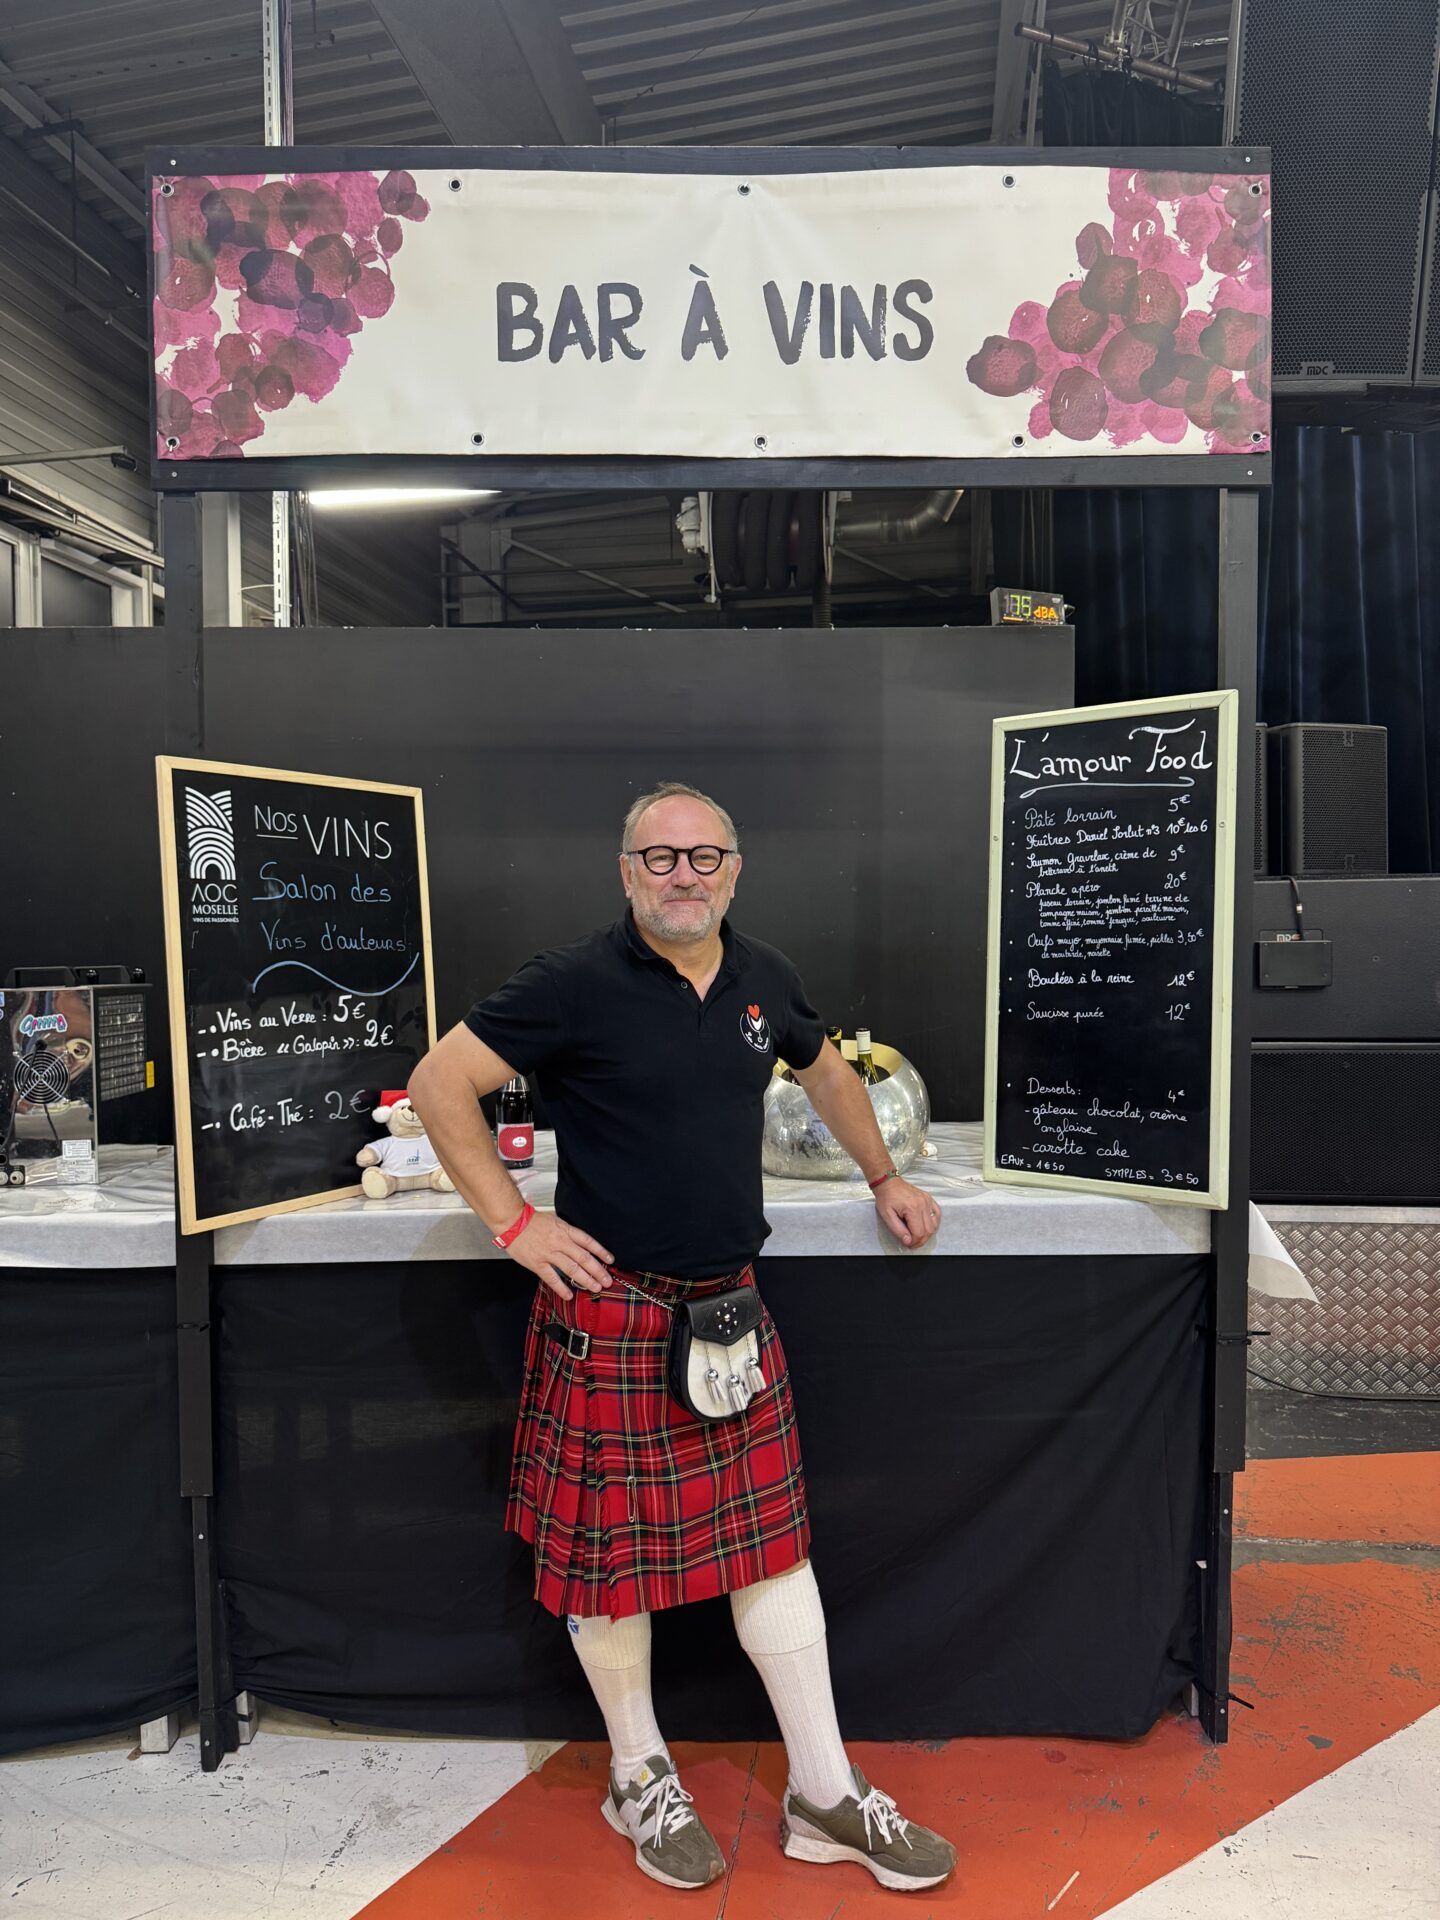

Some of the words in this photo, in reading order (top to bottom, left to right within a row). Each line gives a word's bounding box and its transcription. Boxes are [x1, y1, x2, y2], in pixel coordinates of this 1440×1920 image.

[496, 281, 647, 364] BAR
[681, 264, 729, 362] À
[762, 279, 934, 365] VINS
[1306, 366, 1329, 376] MDC
[1009, 732, 1132, 782] L'amour
[1128, 718, 1213, 773] Food
[1025, 808, 1056, 829] Pâté
[1064, 807, 1117, 824] lorrain
[1167, 794, 1191, 812] 5€
[303, 814, 392, 860] VINS
[1166, 817, 1186, 835] 10€
[1200, 819, 1208, 832] 6
[1026, 852, 1062, 869] Saumon
[1142, 846, 1157, 859] de
[1167, 844, 1186, 862] 9€
[252, 861, 337, 901] Salon
[351, 873, 391, 902] des
[1026, 882, 1068, 898] Planche
[1071, 881, 1101, 899] apéro
[1164, 871, 1188, 890] 20€
[191, 883, 238, 903] AOC
[1174, 893, 1190, 903] de
[192, 904, 239, 915] MOSELLE
[260, 918, 307, 951] Vins
[321, 922, 406, 952] d'auteurs
[1041, 951, 1051, 959] de
[1077, 973, 1088, 984] à
[1091, 969, 1103, 982] la
[1106, 974, 1135, 984] reine
[1167, 970, 1195, 987] 12€
[216, 1007, 252, 1033] Vins
[259, 1016, 279, 1028] au
[1026, 1001, 1070, 1021] Saucisse
[1073, 1006, 1105, 1023] purée
[1165, 1003, 1192, 1021] 12€
[222, 1037, 267, 1062] Bière
[1168, 1089, 1186, 1103] 4€
[1149, 1110, 1188, 1122] crème
[1040, 1118, 1098, 1141] anglaise
[1001, 1154, 1025, 1166] EAUX
[1096, 1140, 1131, 1158] cake
